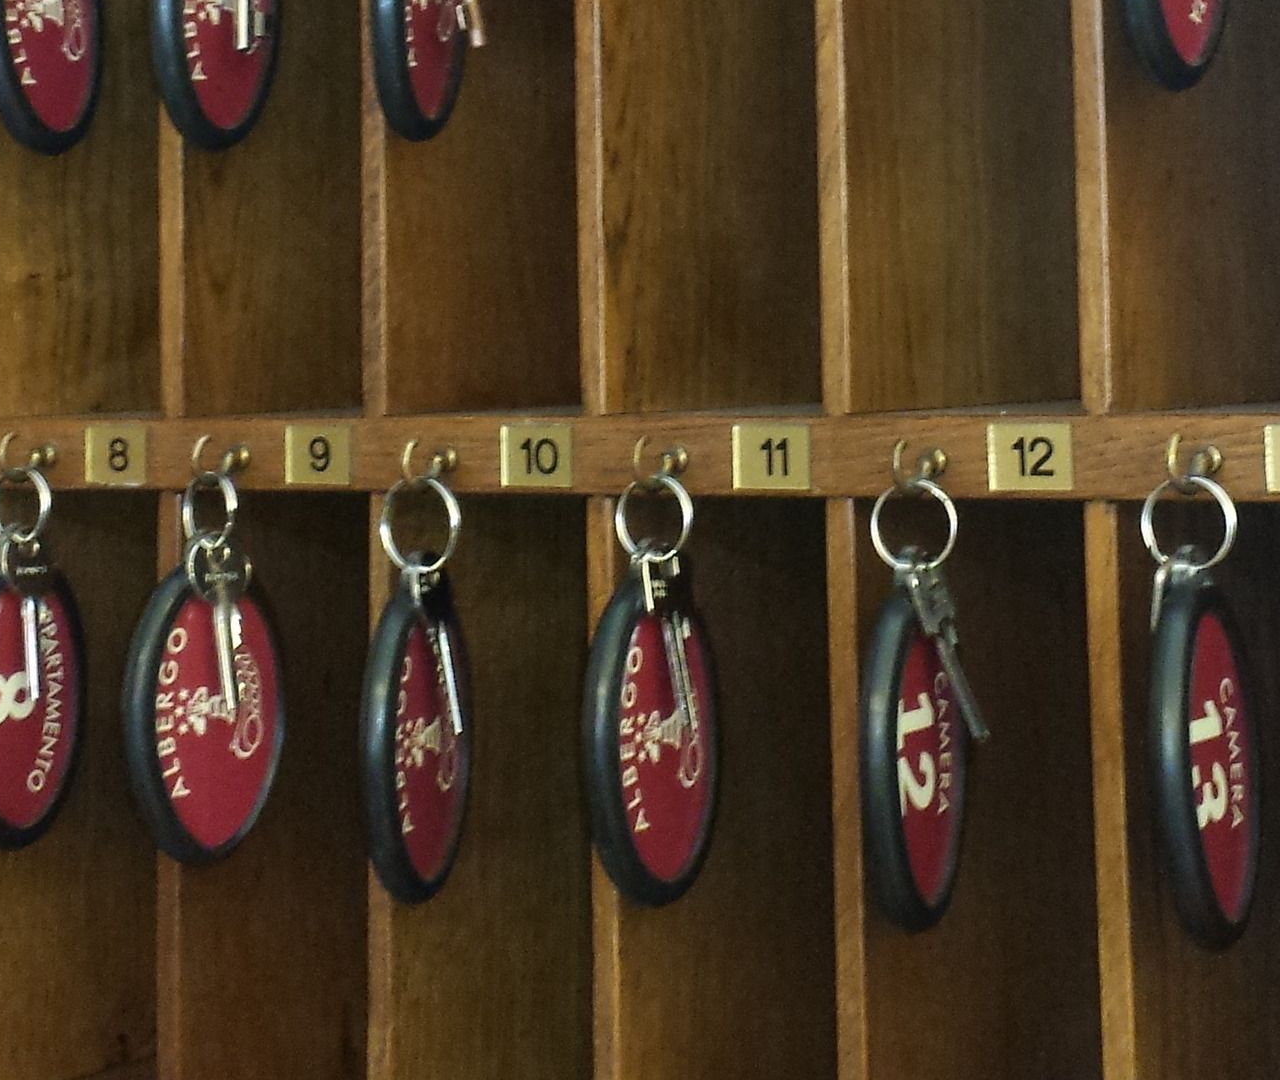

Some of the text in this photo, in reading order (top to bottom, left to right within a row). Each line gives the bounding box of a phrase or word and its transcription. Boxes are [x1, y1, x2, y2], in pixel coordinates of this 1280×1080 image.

[107, 437, 130, 472] 8
[308, 436, 331, 473] 9
[520, 438, 559, 475] 10
[759, 440, 790, 477] 11
[1011, 437, 1056, 477] 12
[155, 626, 192, 800] ALBERGO
[619, 645, 651, 833] ALBERGO
[933, 671, 954, 815] CAMERA
[1219, 677, 1244, 829] CAMERA
[898, 692, 937, 817] 12
